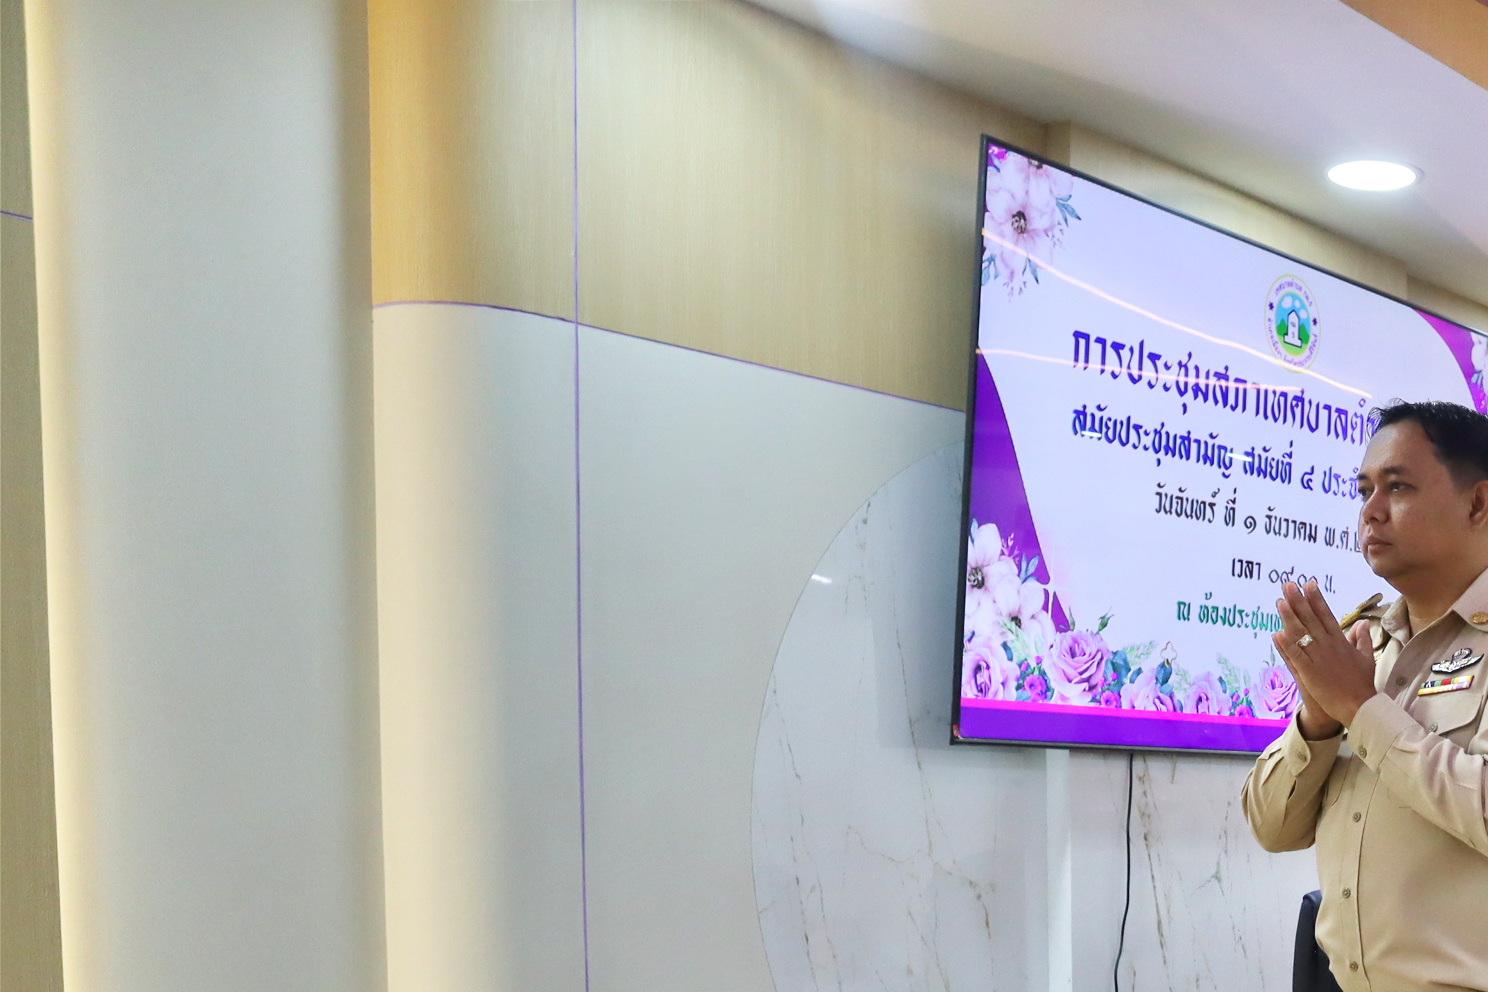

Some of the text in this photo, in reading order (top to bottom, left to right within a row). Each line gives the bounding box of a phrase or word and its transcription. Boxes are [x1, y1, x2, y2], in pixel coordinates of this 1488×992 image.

[1072, 404, 1234, 478] สมัยประชุมสามัญ
[1242, 440, 1293, 485] สมัยที่
[1301, 465, 1314, 491] ๔
[1155, 482, 1221, 524] วันจันทร์
[1224, 488, 1237, 527] ที่
[1243, 515, 1257, 534] ๑
[1264, 506, 1318, 544] ธันวาคม
[1231, 557, 1261, 580] เวลา
[1324, 574, 1336, 594] น.
[1177, 600, 1191, 622] ณ
